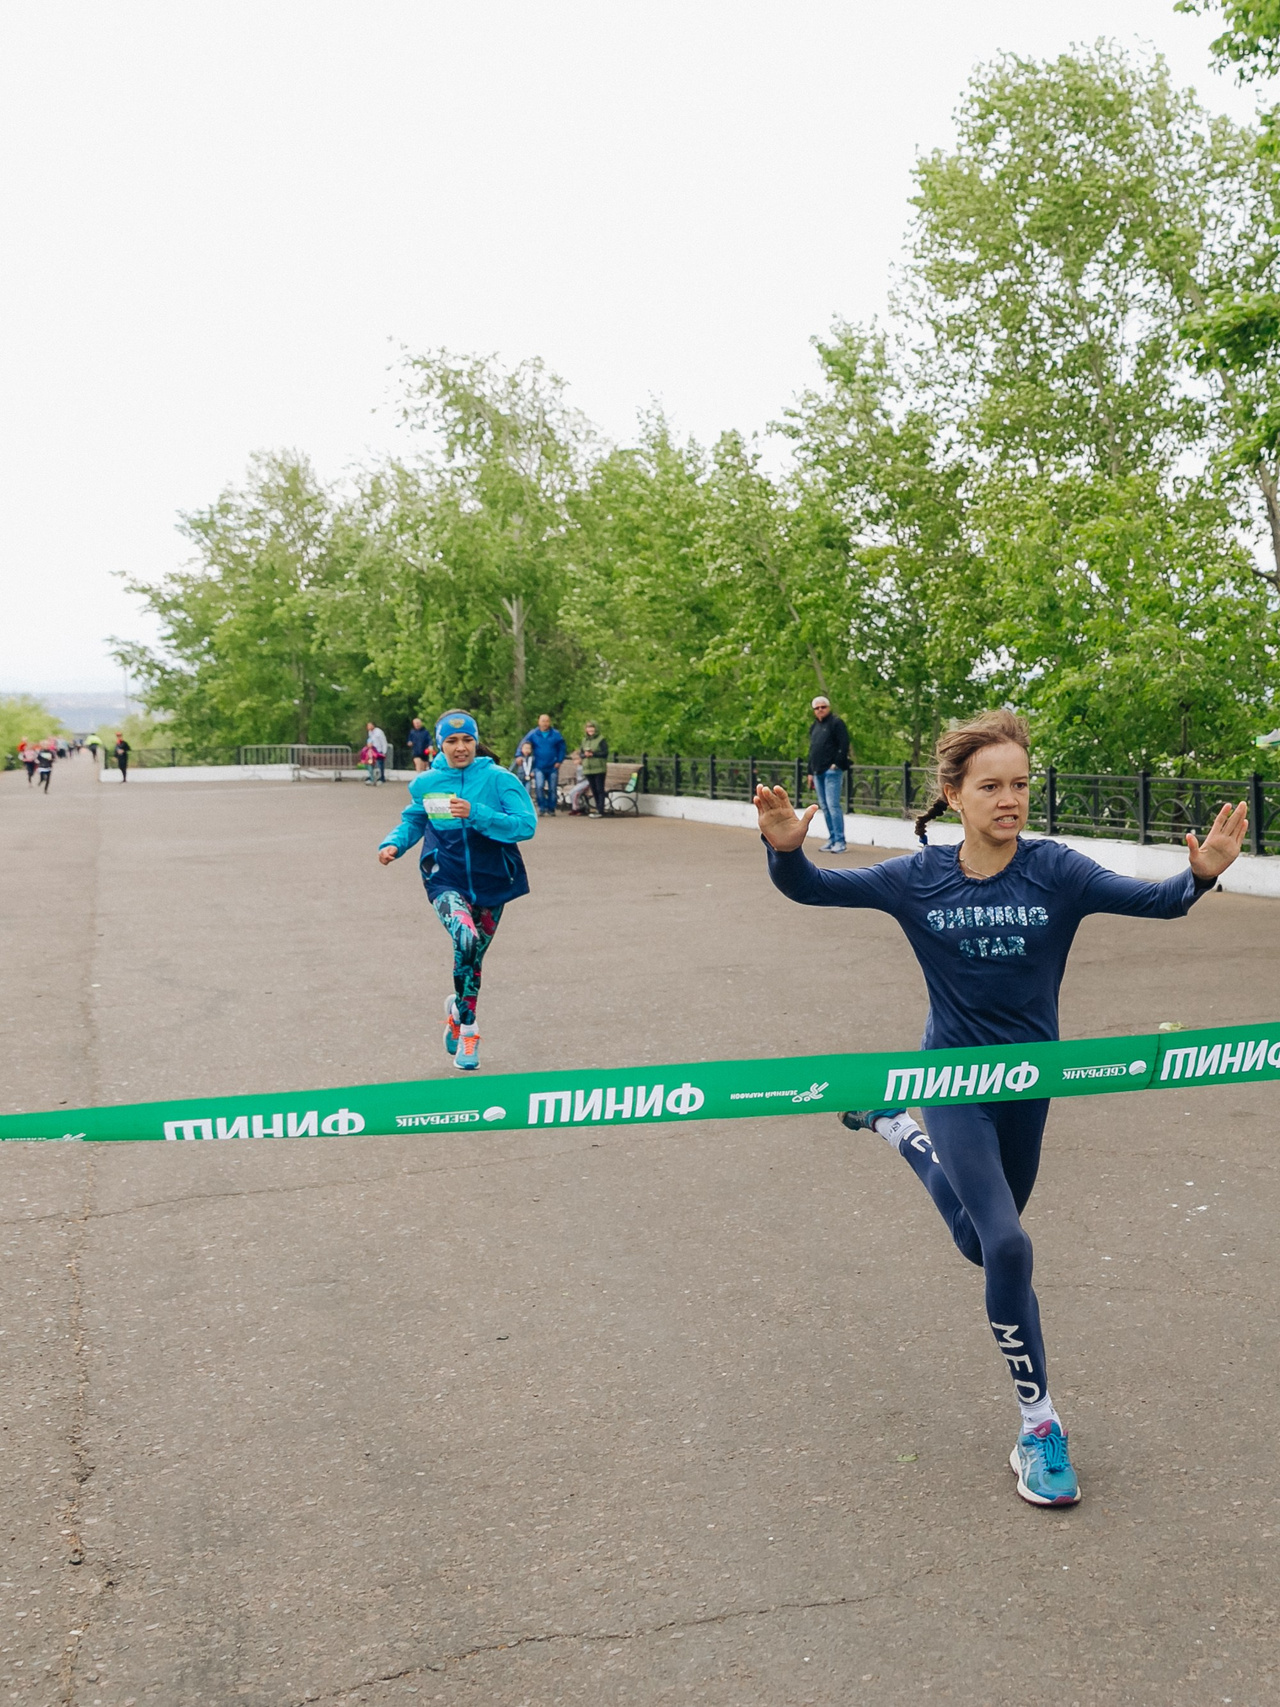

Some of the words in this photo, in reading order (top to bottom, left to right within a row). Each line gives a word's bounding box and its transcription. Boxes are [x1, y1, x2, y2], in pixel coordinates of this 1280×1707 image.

[927, 906, 1049, 931] SHINING
[958, 935, 1027, 958] STAR
[883, 1062, 1040, 1102] ФИНИШ
[1062, 1065, 1127, 1080] СБЕРБАНК
[528, 1083, 705, 1126] ФИНИШ
[730, 1092, 764, 1100] МАРАФОН
[163, 1108, 366, 1141] ФИНИШ
[396, 1111, 480, 1128] СБЕРБАНК
